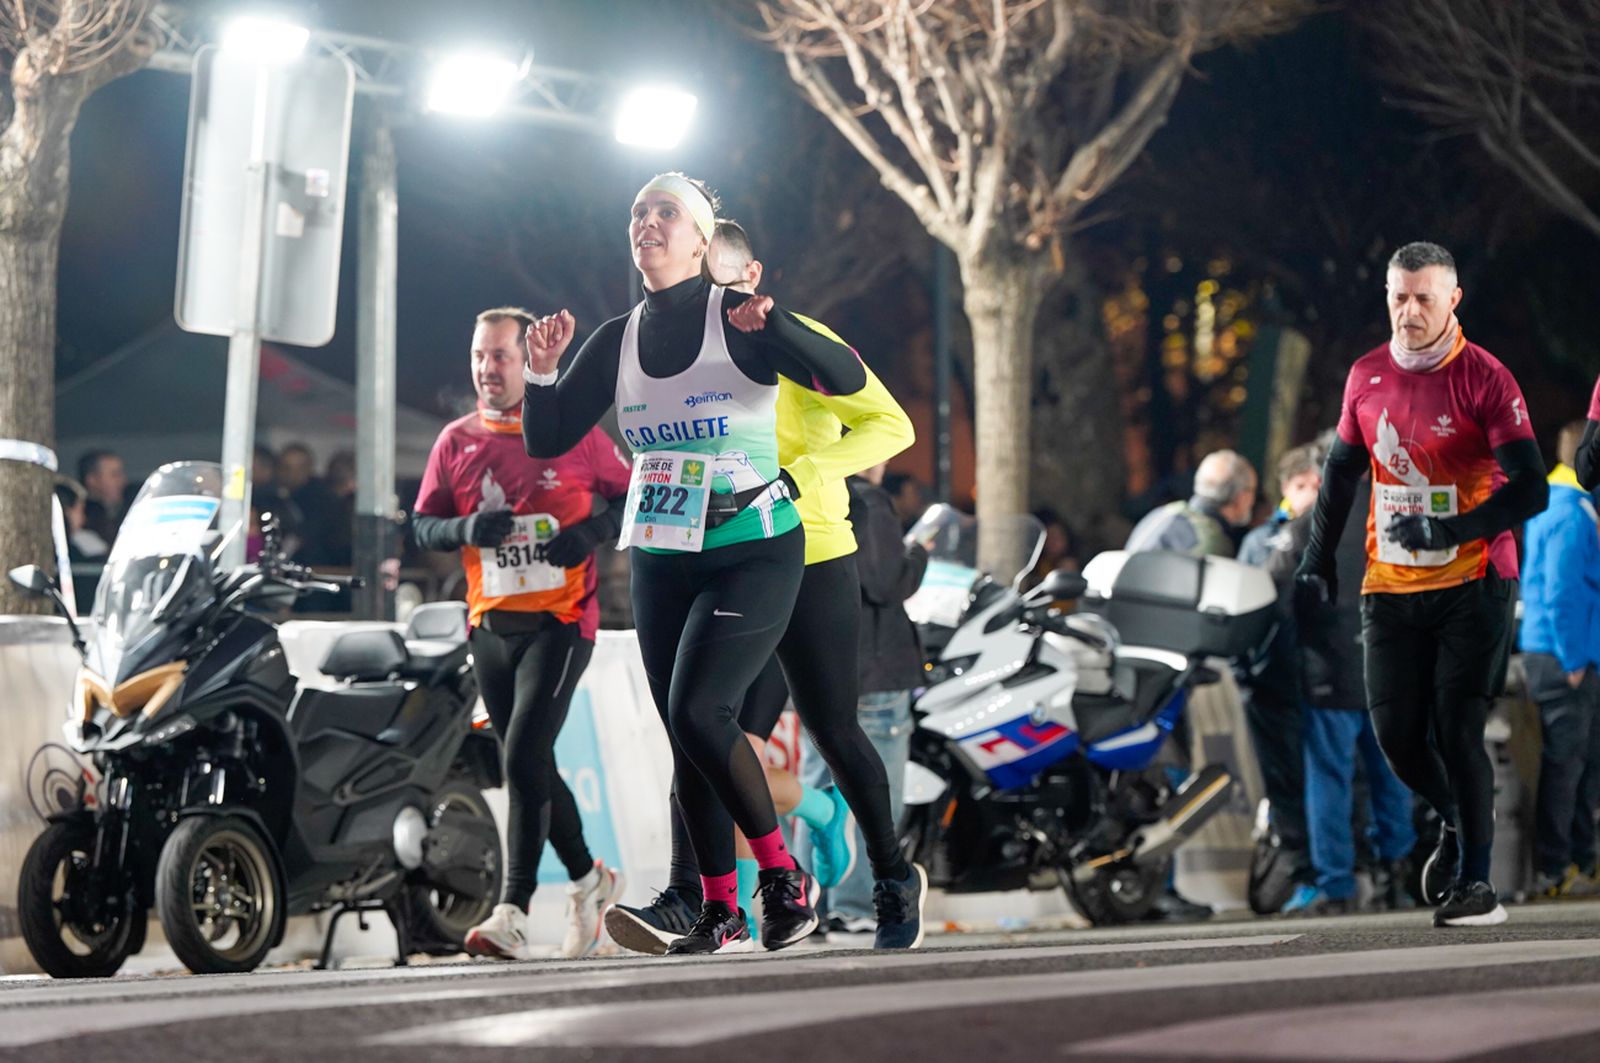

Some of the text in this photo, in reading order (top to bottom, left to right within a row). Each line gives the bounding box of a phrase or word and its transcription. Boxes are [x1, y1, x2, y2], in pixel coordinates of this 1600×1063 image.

[657, 416, 730, 442] GILETE
[1388, 452, 1410, 476] 43
[639, 484, 689, 516] 322
